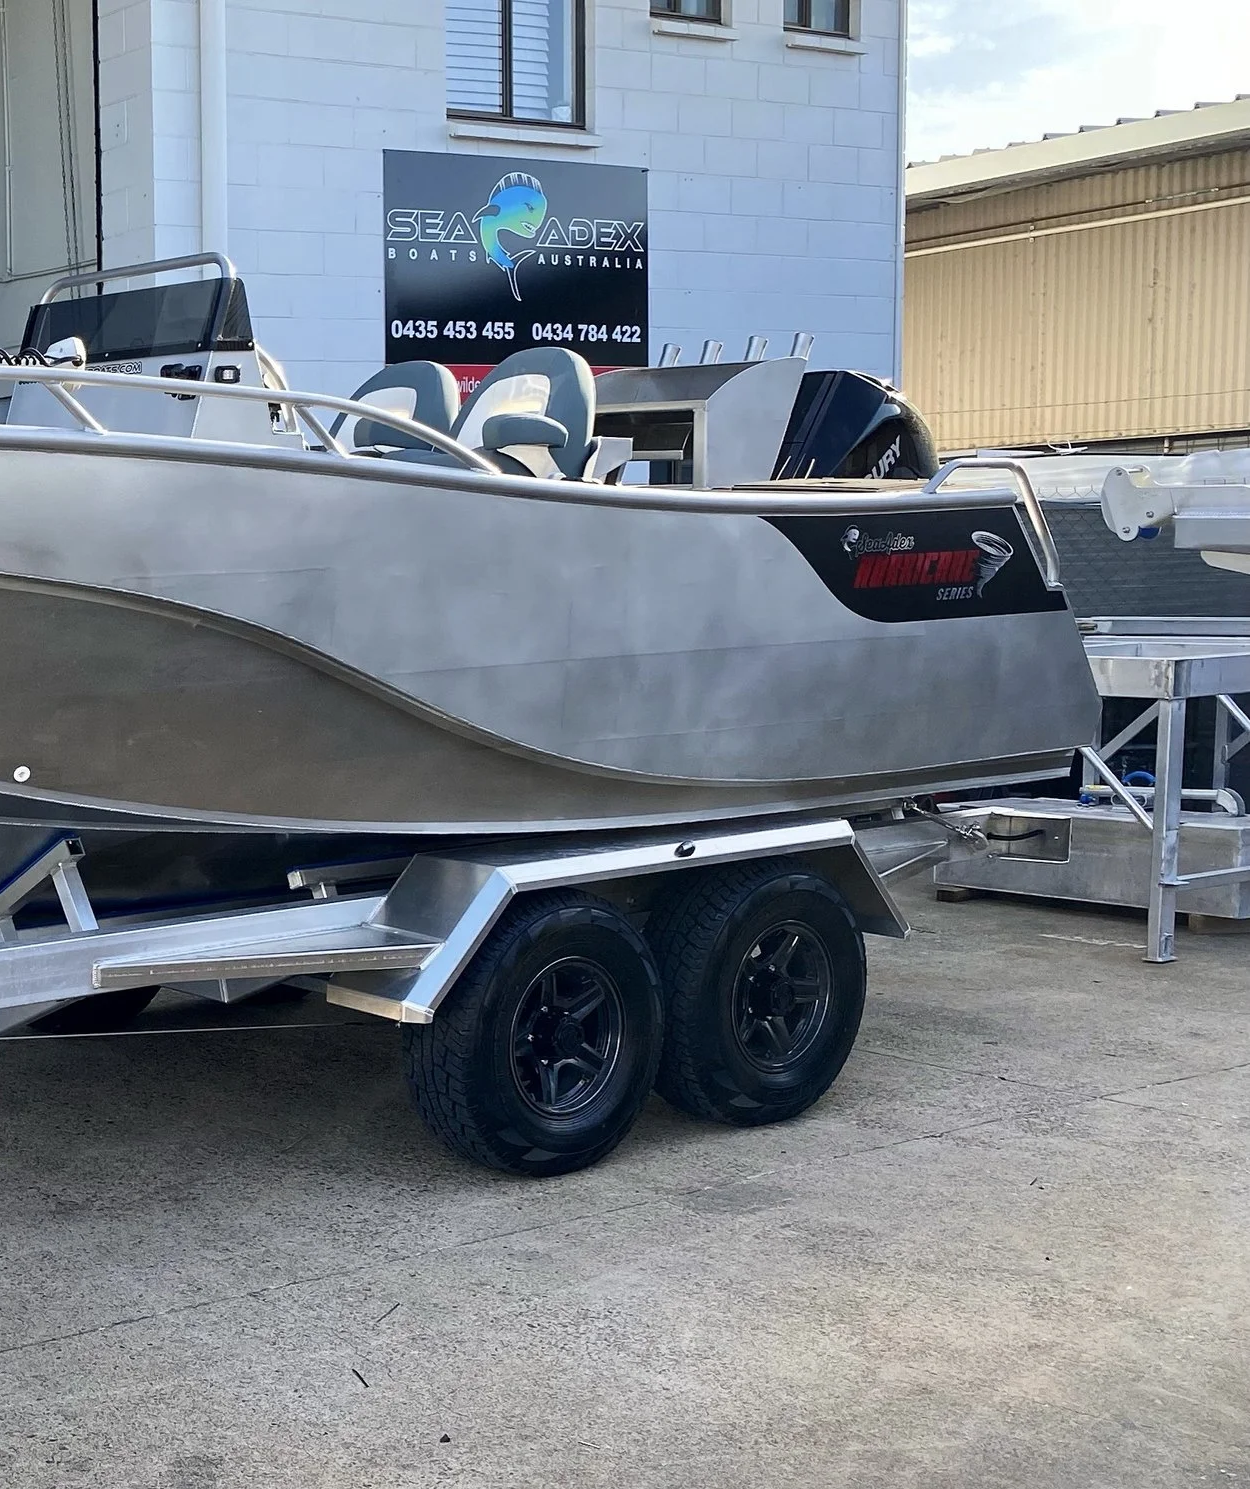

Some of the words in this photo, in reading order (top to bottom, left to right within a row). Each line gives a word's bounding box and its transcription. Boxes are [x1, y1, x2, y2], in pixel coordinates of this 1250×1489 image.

[386, 209, 478, 243] SEA
[536, 217, 645, 252] ADEX
[388, 248, 477, 262] BOATS
[537, 254, 643, 269] AUSTRALIA
[391, 320, 438, 339] 0435
[443, 320, 477, 339] 453
[482, 322, 515, 340] 455
[532, 323, 573, 341] 0434
[578, 324, 608, 342] 784
[612, 325, 642, 343] 422
[936, 586, 974, 600] SERIES
